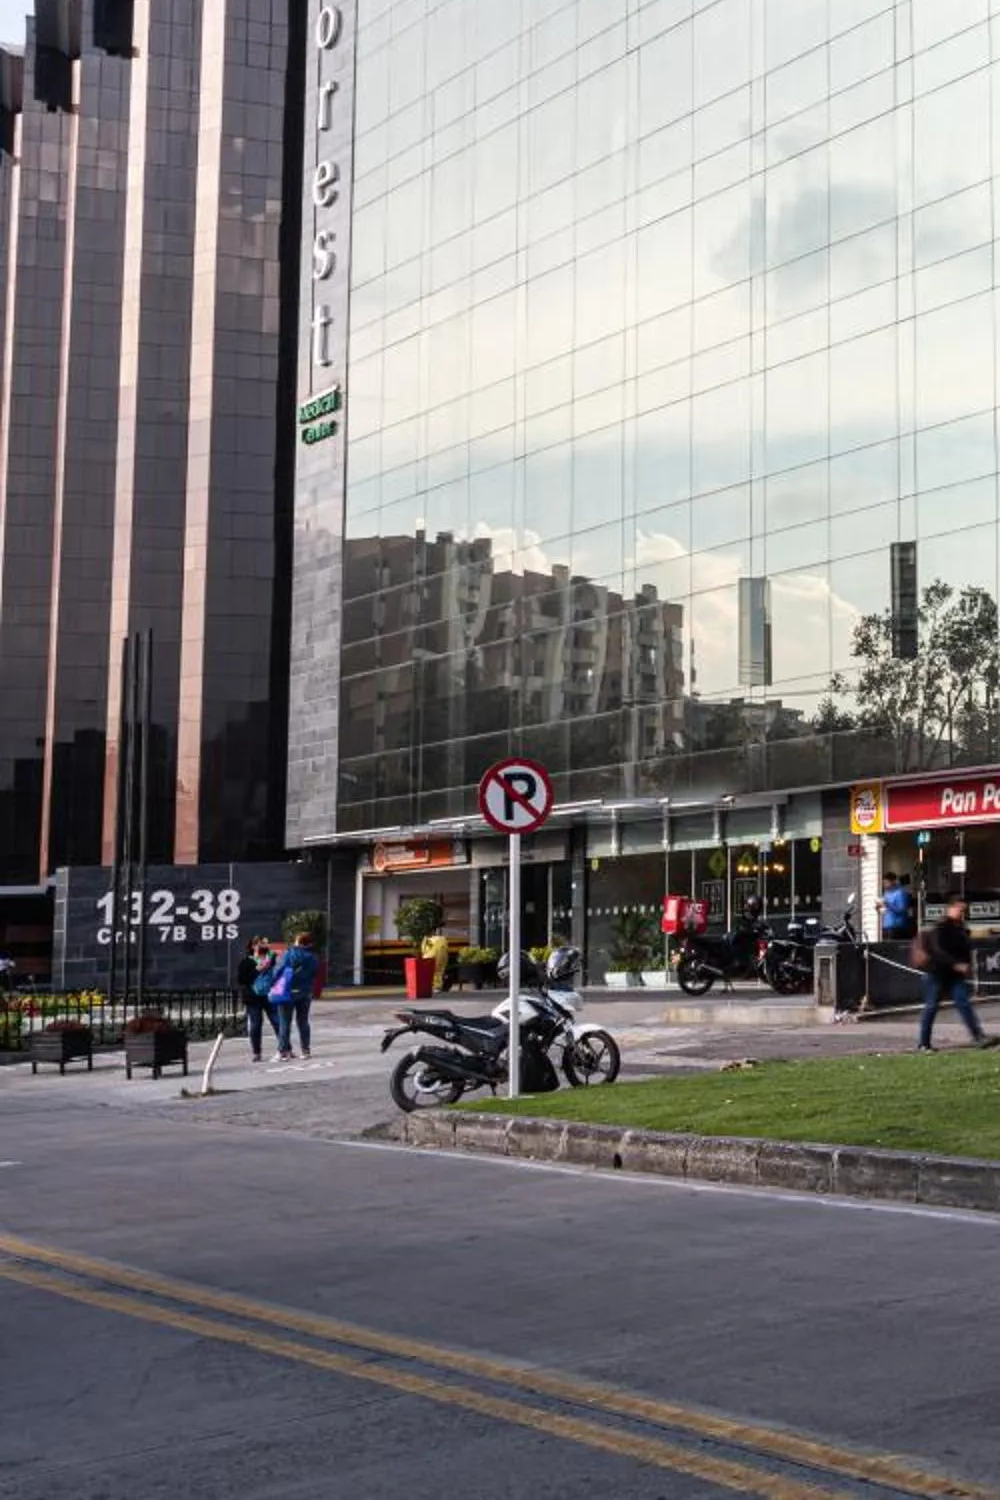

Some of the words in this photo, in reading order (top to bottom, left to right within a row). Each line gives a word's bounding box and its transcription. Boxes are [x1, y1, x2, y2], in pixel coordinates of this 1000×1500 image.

[503, 772, 537, 821] P
[940, 787, 977, 815] Pan
[158, 926, 187, 942] 7B
[201, 924, 240, 941] BIS
